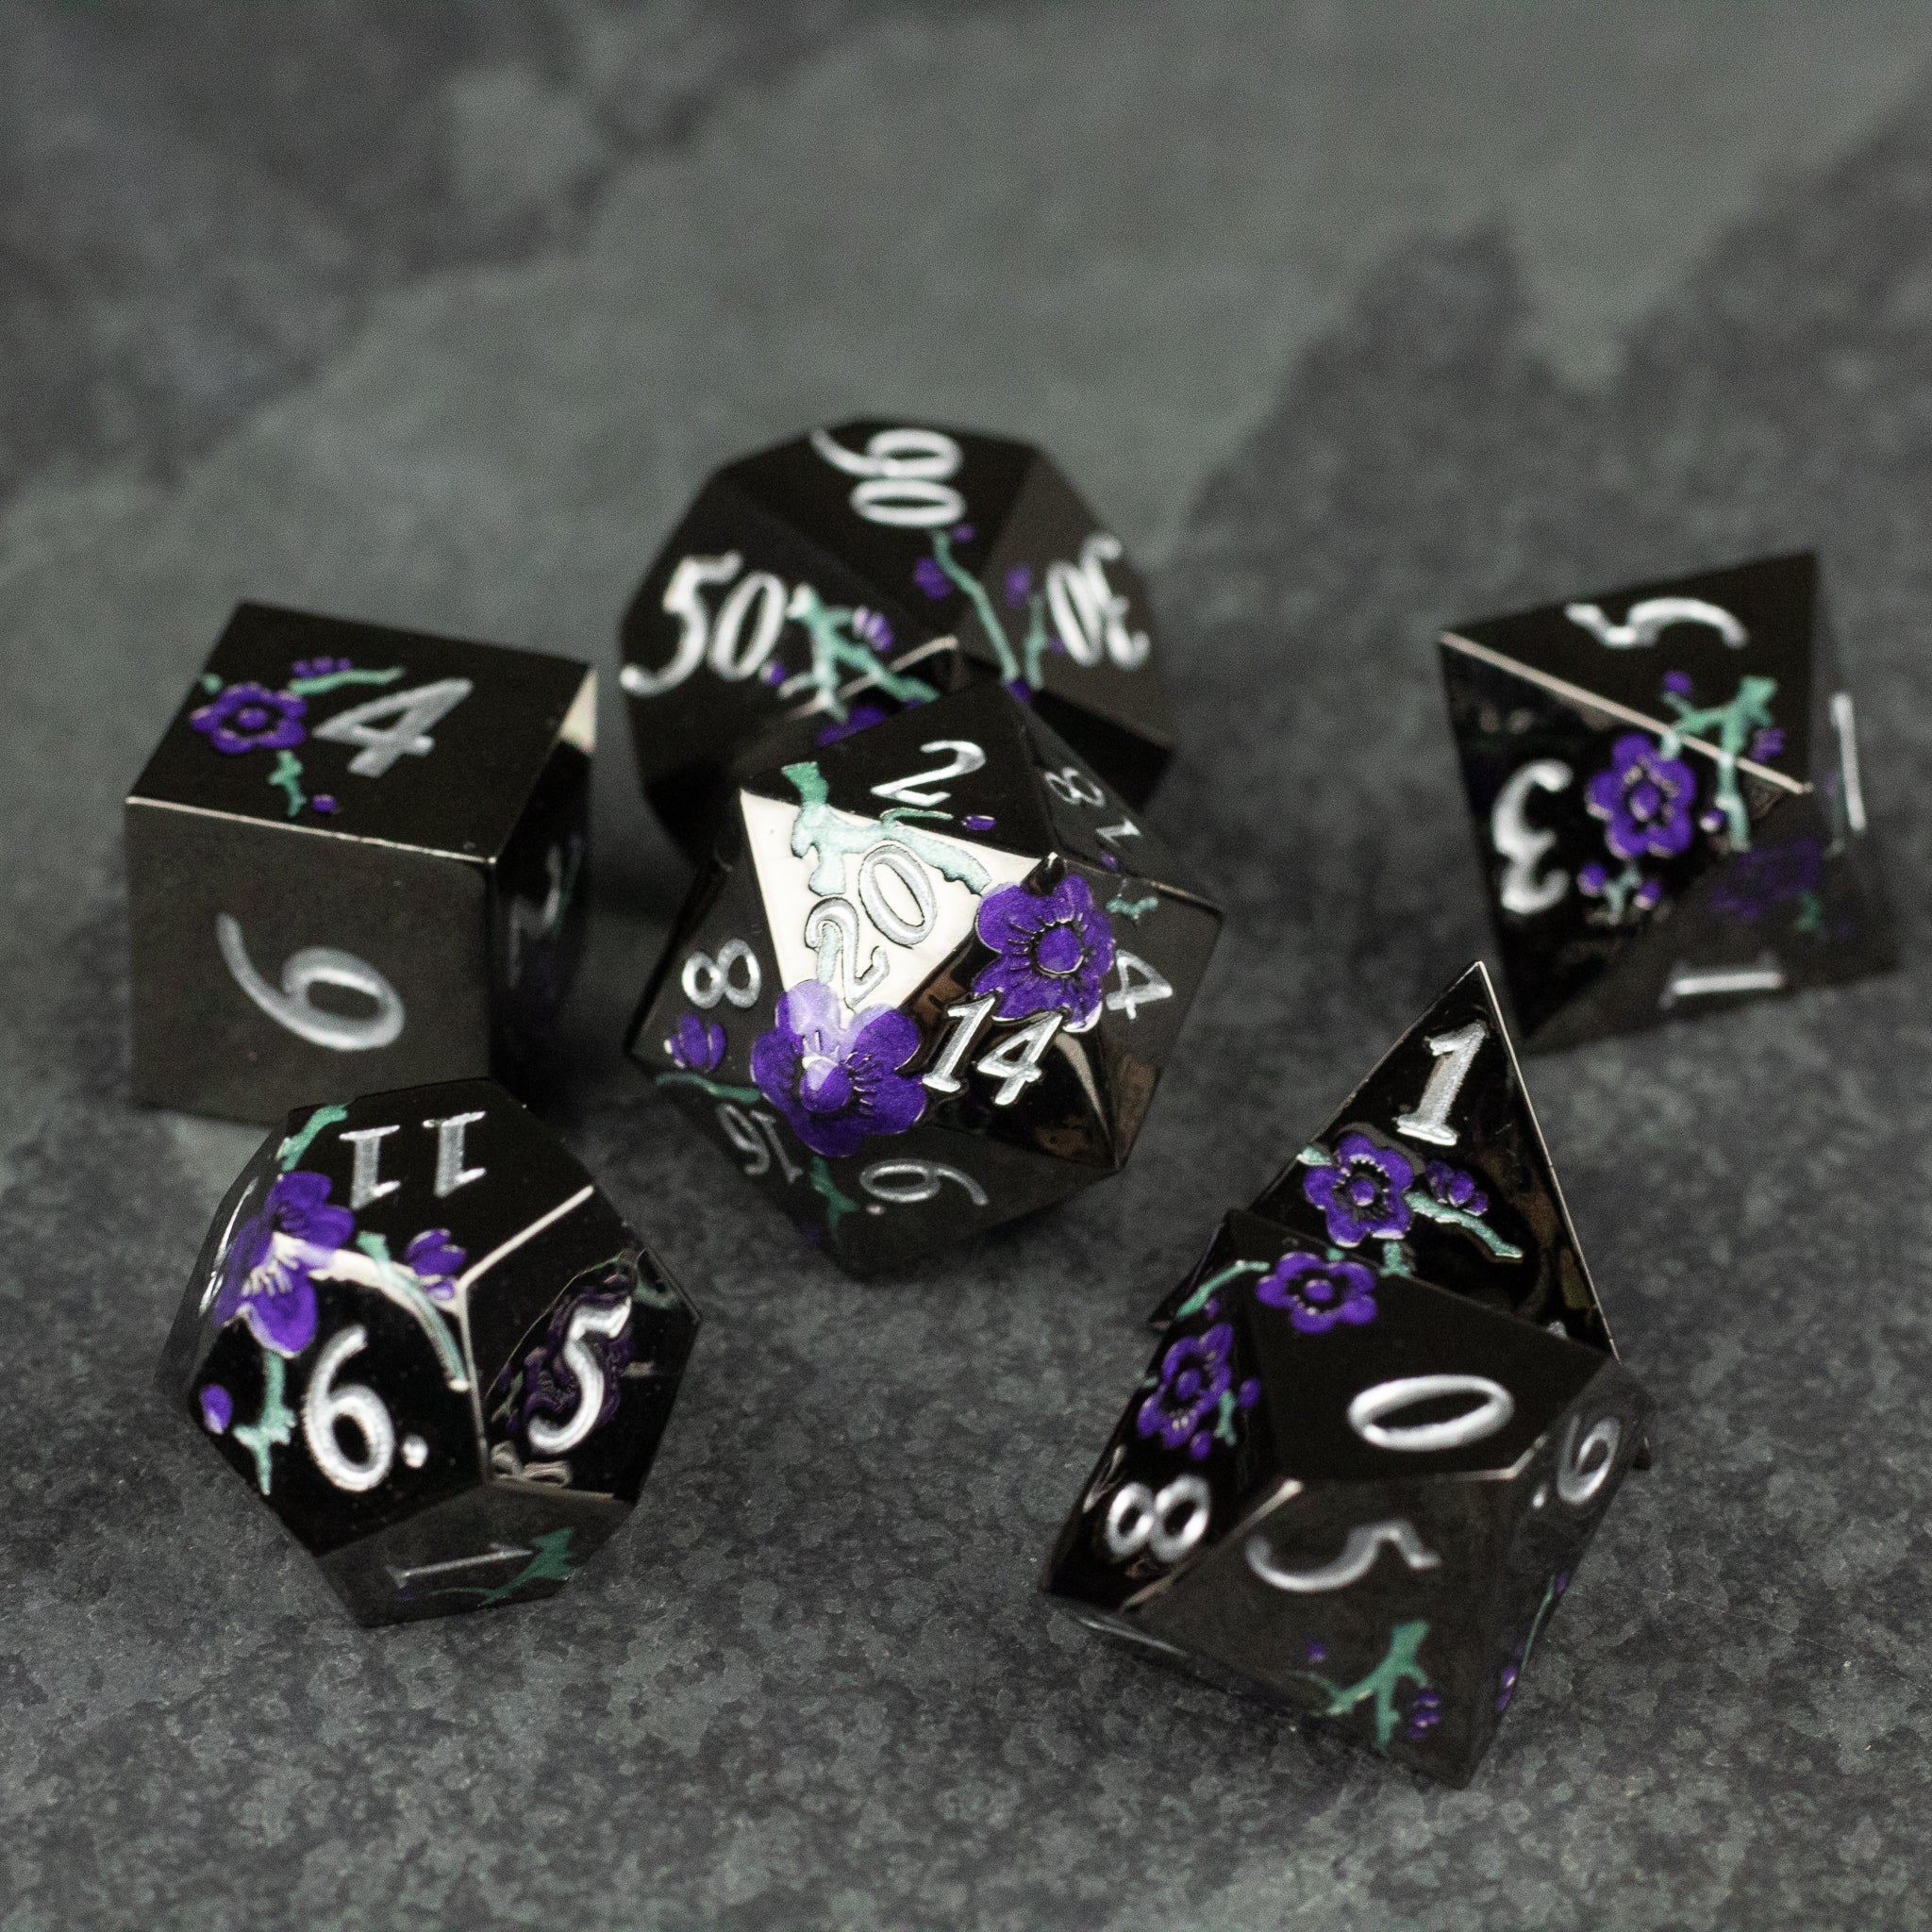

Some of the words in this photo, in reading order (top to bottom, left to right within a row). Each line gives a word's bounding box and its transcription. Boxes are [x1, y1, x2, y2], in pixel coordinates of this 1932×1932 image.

[810, 428, 966, 527] 90
[620, 551, 788, 697] 50
[1564, 598, 1750, 649] 5
[313, 677, 474, 777] 4
[871, 741, 987, 807] 2
[1491, 758, 1572, 914] 3
[681, 939, 761, 1009] 8
[805, 841, 937, 1008] 20
[217, 912, 405, 1052] 6
[1106, 949, 1174, 1019] 4
[921, 993, 1066, 1106] 14
[1395, 1019, 1488, 1147] 1
[339, 1110, 487, 1210] 11
[714, 1102, 805, 1186] 16
[526, 1293, 632, 1456] 5
[1346, 1374, 1514, 1453] 0
[1105, 1474, 1212, 1564] 8
[1244, 1518, 1441, 1593] 5
